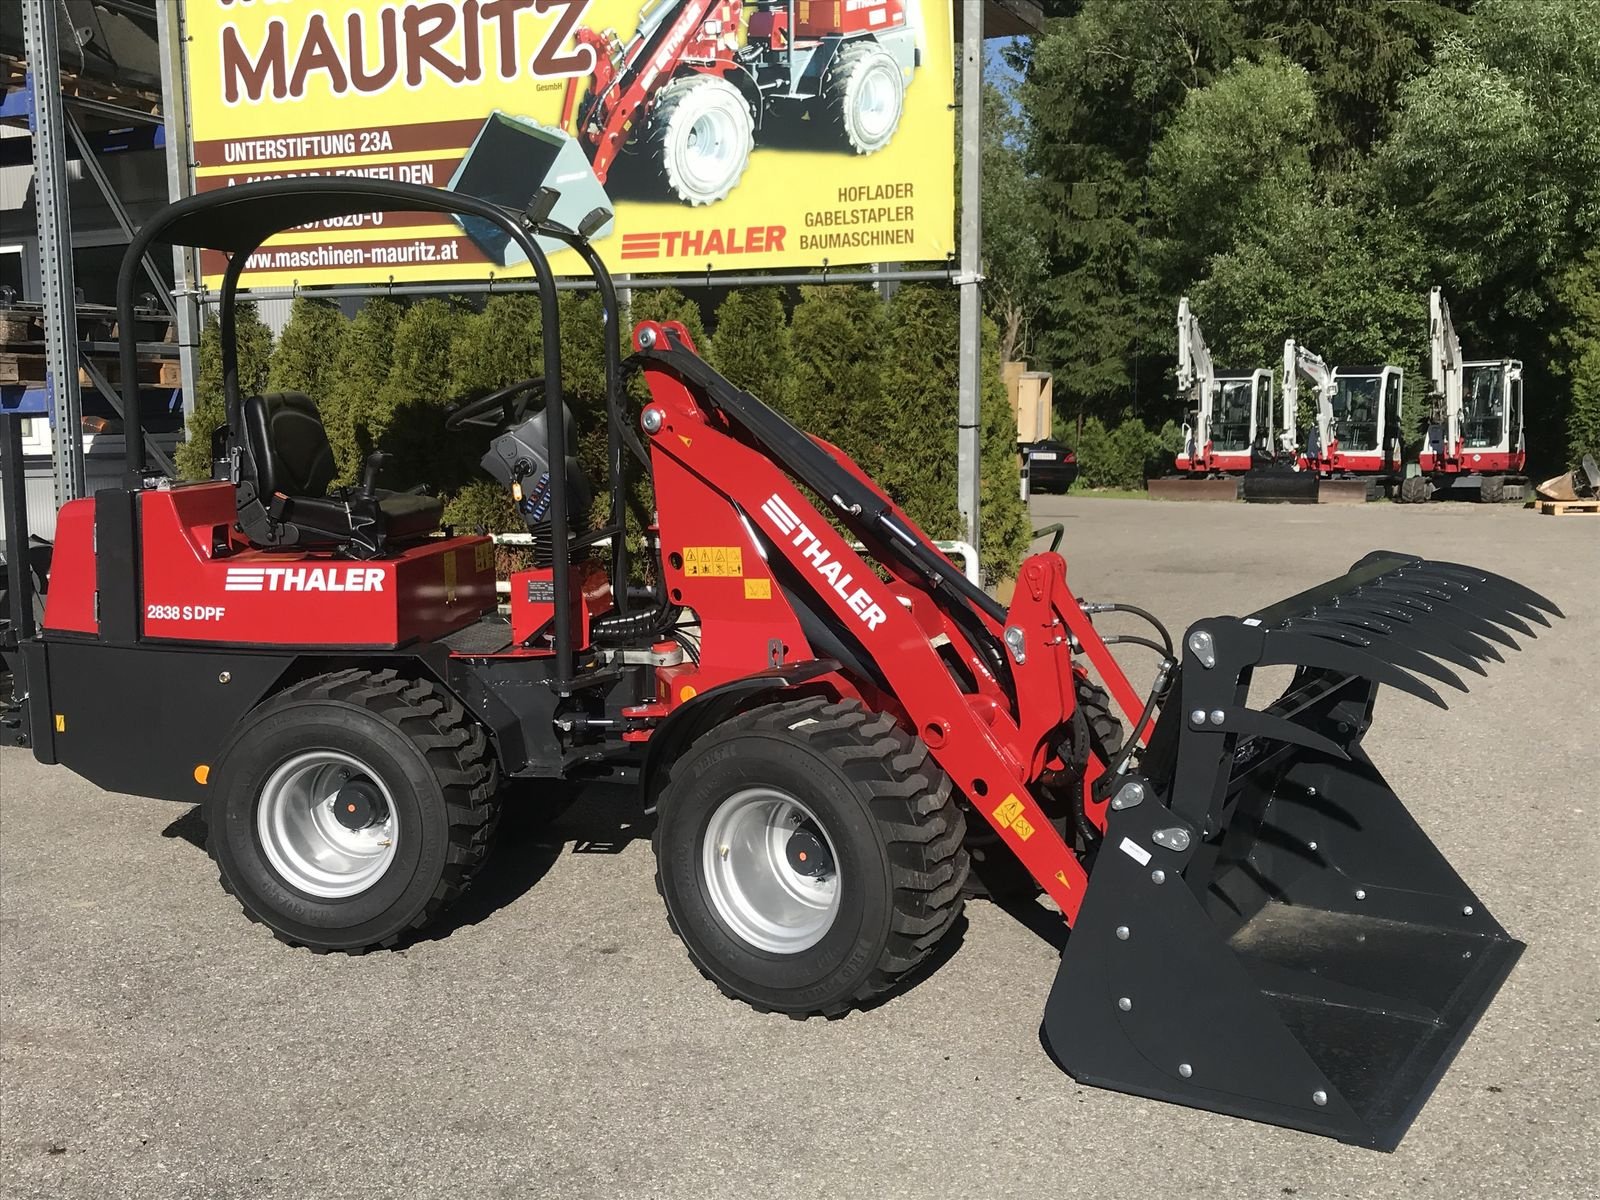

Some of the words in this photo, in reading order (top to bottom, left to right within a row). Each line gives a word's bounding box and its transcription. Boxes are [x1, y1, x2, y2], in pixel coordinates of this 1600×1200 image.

[221, 0, 592, 102] MAURITZ
[535, 82, 563, 92] GesmbH
[224, 133, 355, 163] UNTERSTIFTUNG
[359, 130, 393, 153] 23A
[335, 164, 433, 185] FELDEN
[837, 182, 914, 203] HOFLADER
[804, 205, 914, 228] GABELSTAPLER
[661, 225, 787, 258] THALER
[799, 229, 914, 251] BAUMASCHINEN
[229, 240, 459, 270] ww.maschinen-mauritz.at
[264, 568, 386, 592] THALER
[791, 523, 887, 632] THALER
[147, 605, 181, 620] 2838
[182, 606, 193, 621] S
[194, 606, 226, 621] DPF
